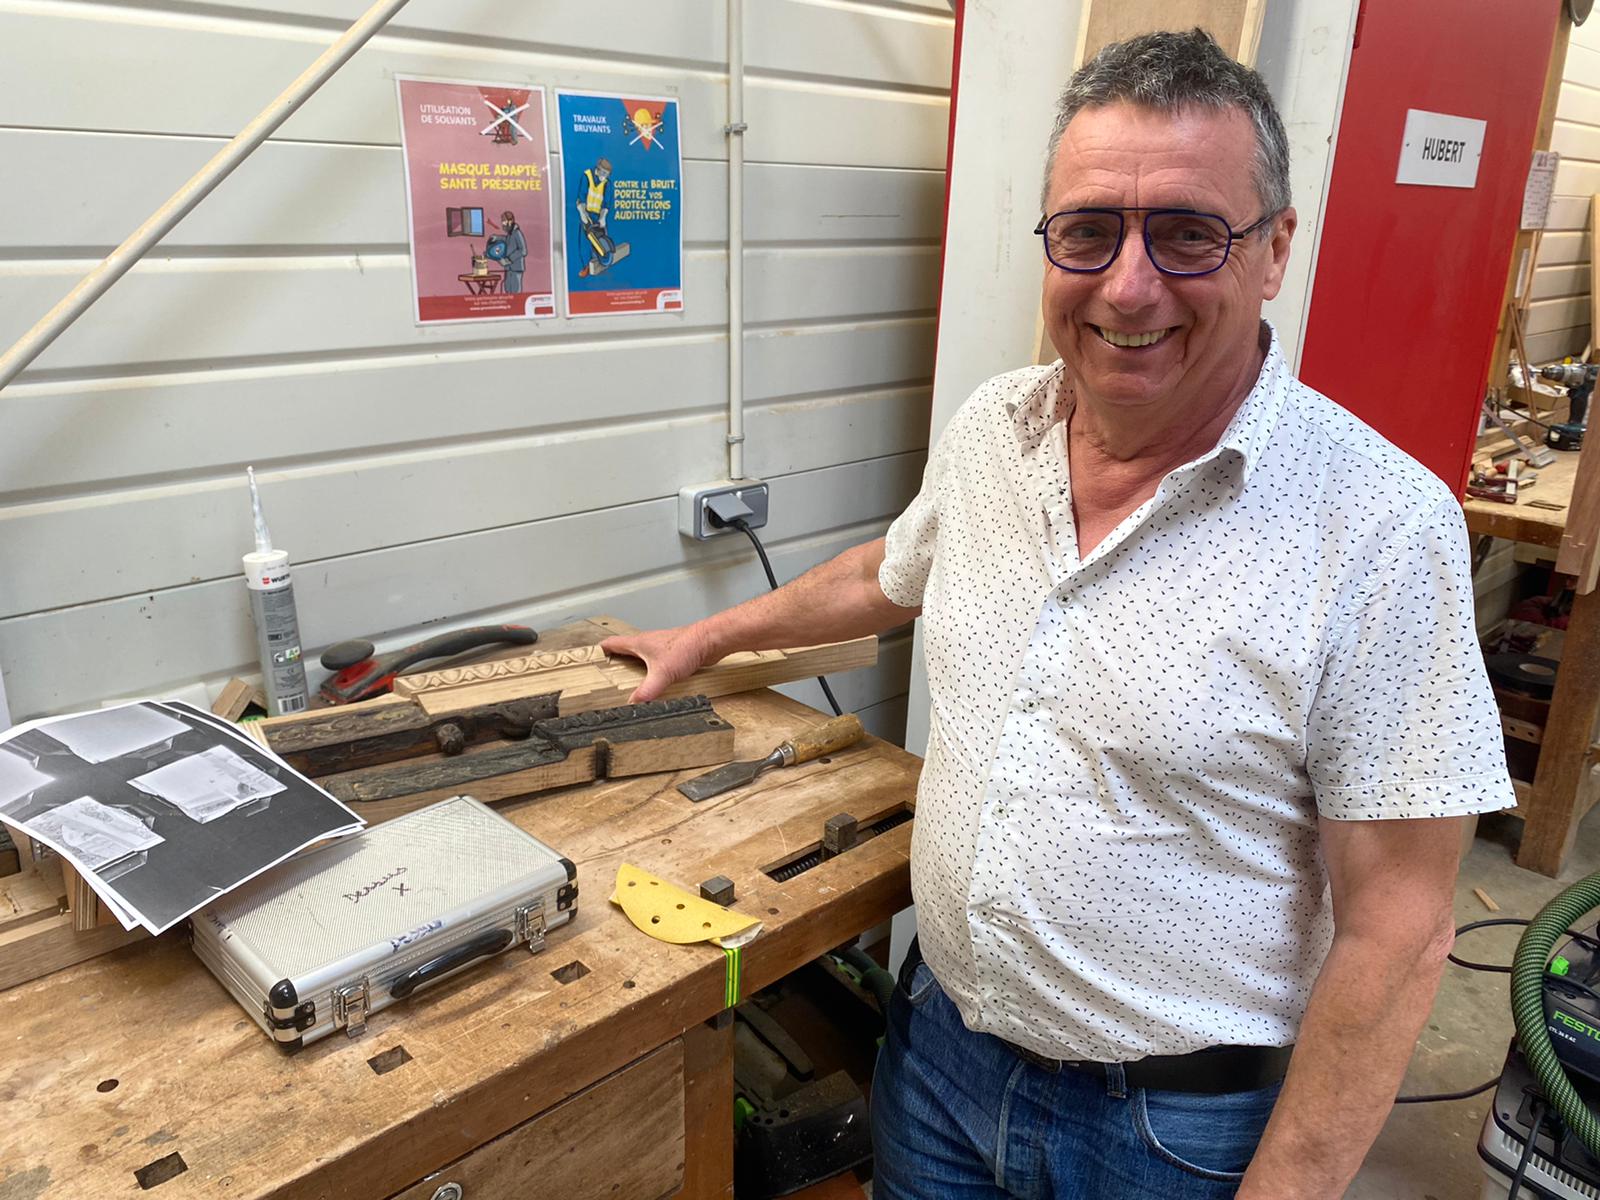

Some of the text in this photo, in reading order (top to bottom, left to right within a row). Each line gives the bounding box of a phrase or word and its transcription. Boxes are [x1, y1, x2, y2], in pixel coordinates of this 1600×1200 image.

[420, 104, 471, 114] UTILISATION
[421, 115, 477, 126] DE SOLVANTS
[573, 114, 606, 124] TRAVAUX
[574, 124, 611, 134] BRUYANTS
[1422, 137, 1466, 163] HUBERT
[439, 163, 491, 175] MASQUE
[614, 180, 639, 188] CONTRE
[614, 189, 646, 199] PORTEZ
[614, 200, 671, 210] PROTECTIONS
